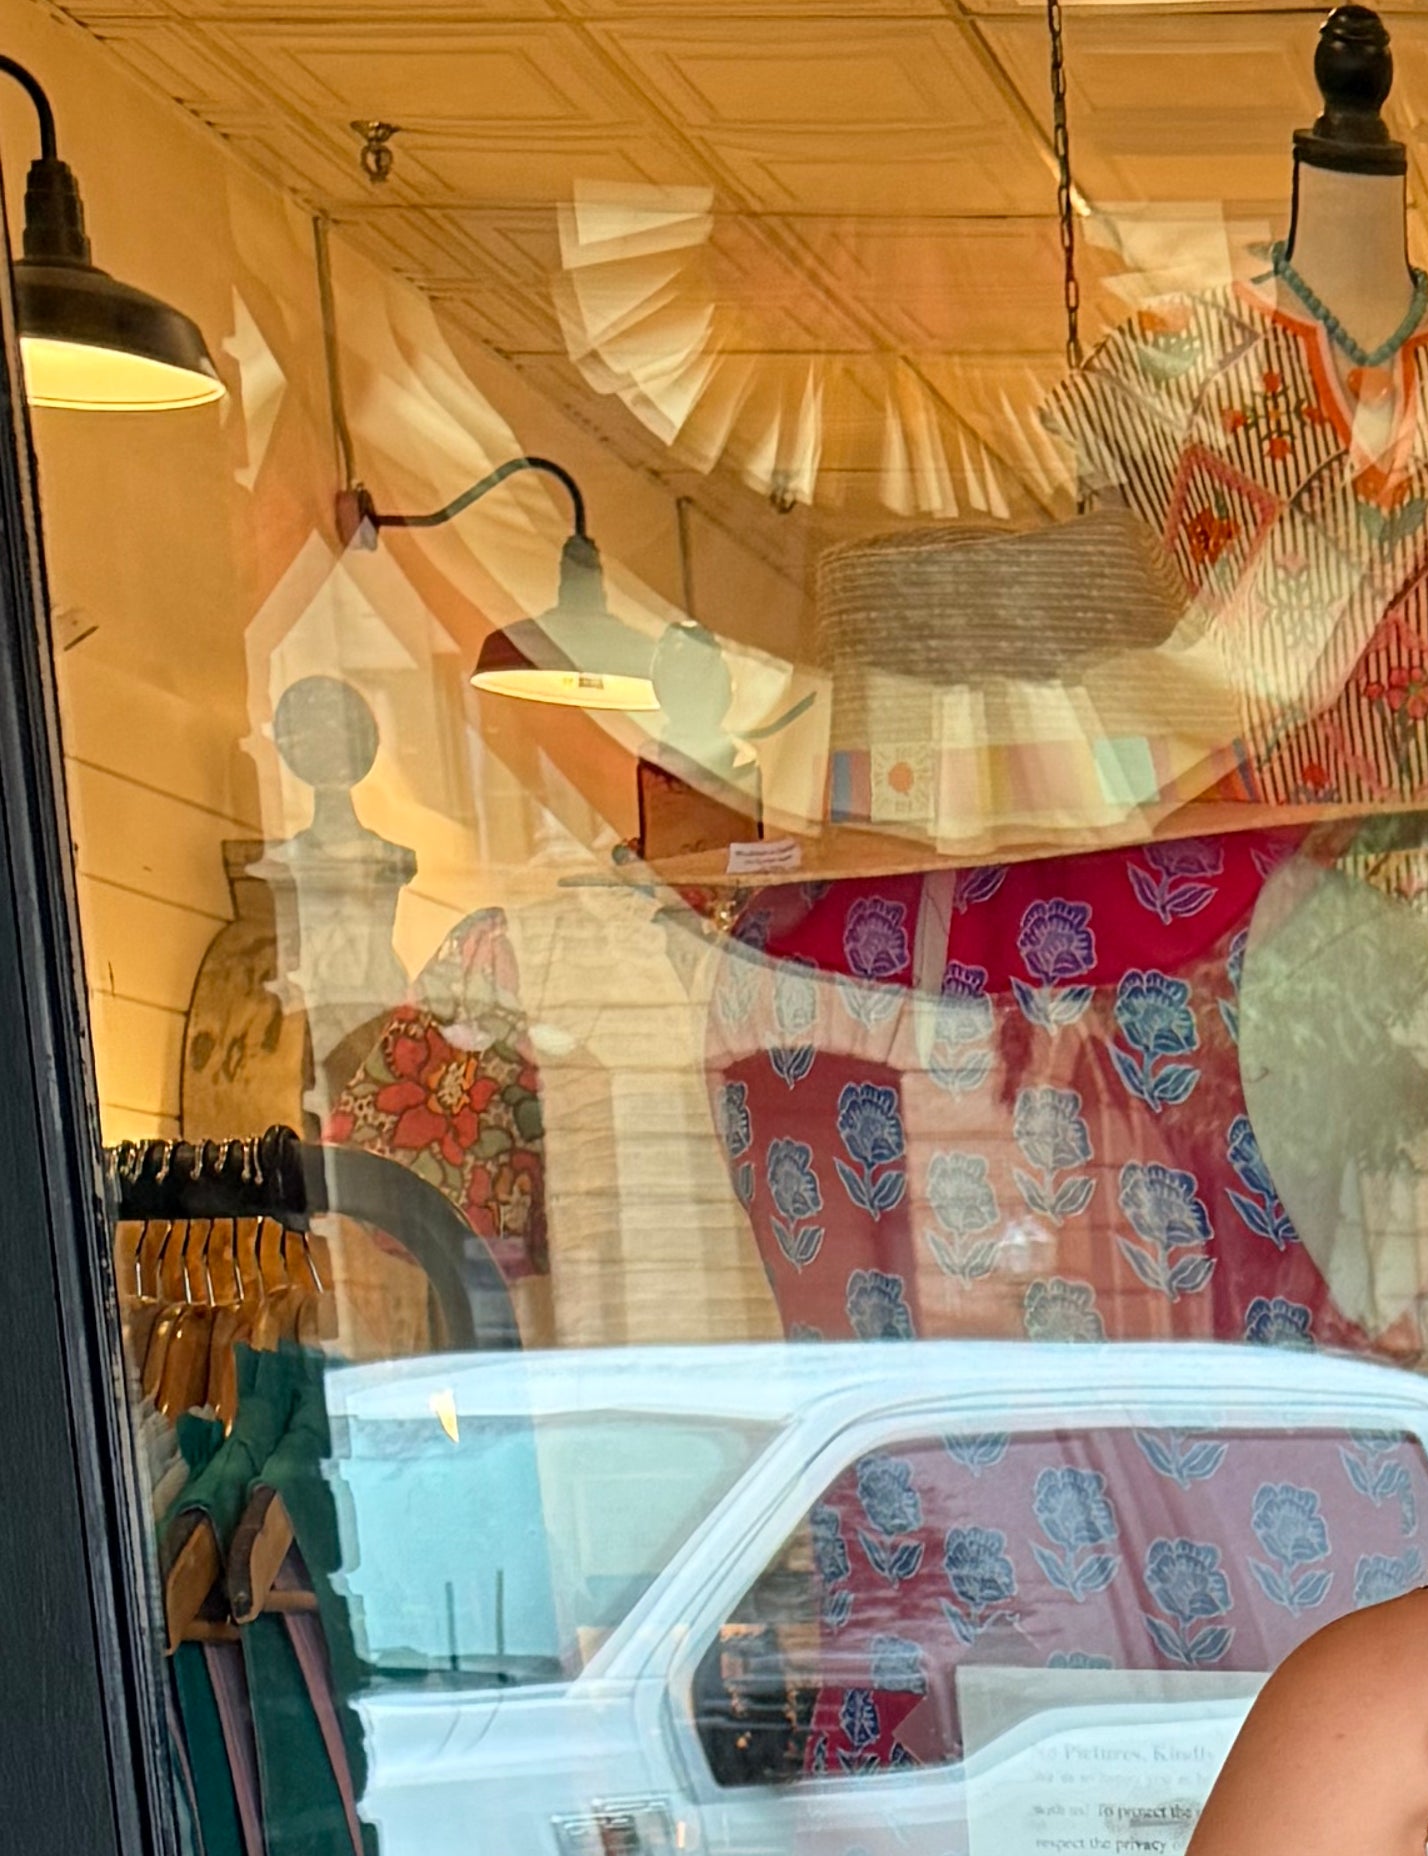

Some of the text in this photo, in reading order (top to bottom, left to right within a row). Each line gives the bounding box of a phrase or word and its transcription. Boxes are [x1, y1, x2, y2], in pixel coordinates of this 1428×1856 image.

[1117, 1806, 1167, 1821] protect
[1170, 1803, 1192, 1819] the
[1036, 1838, 1085, 1852] respect
[1089, 1836, 1111, 1850] the
[1115, 1836, 1167, 1854] privacy
